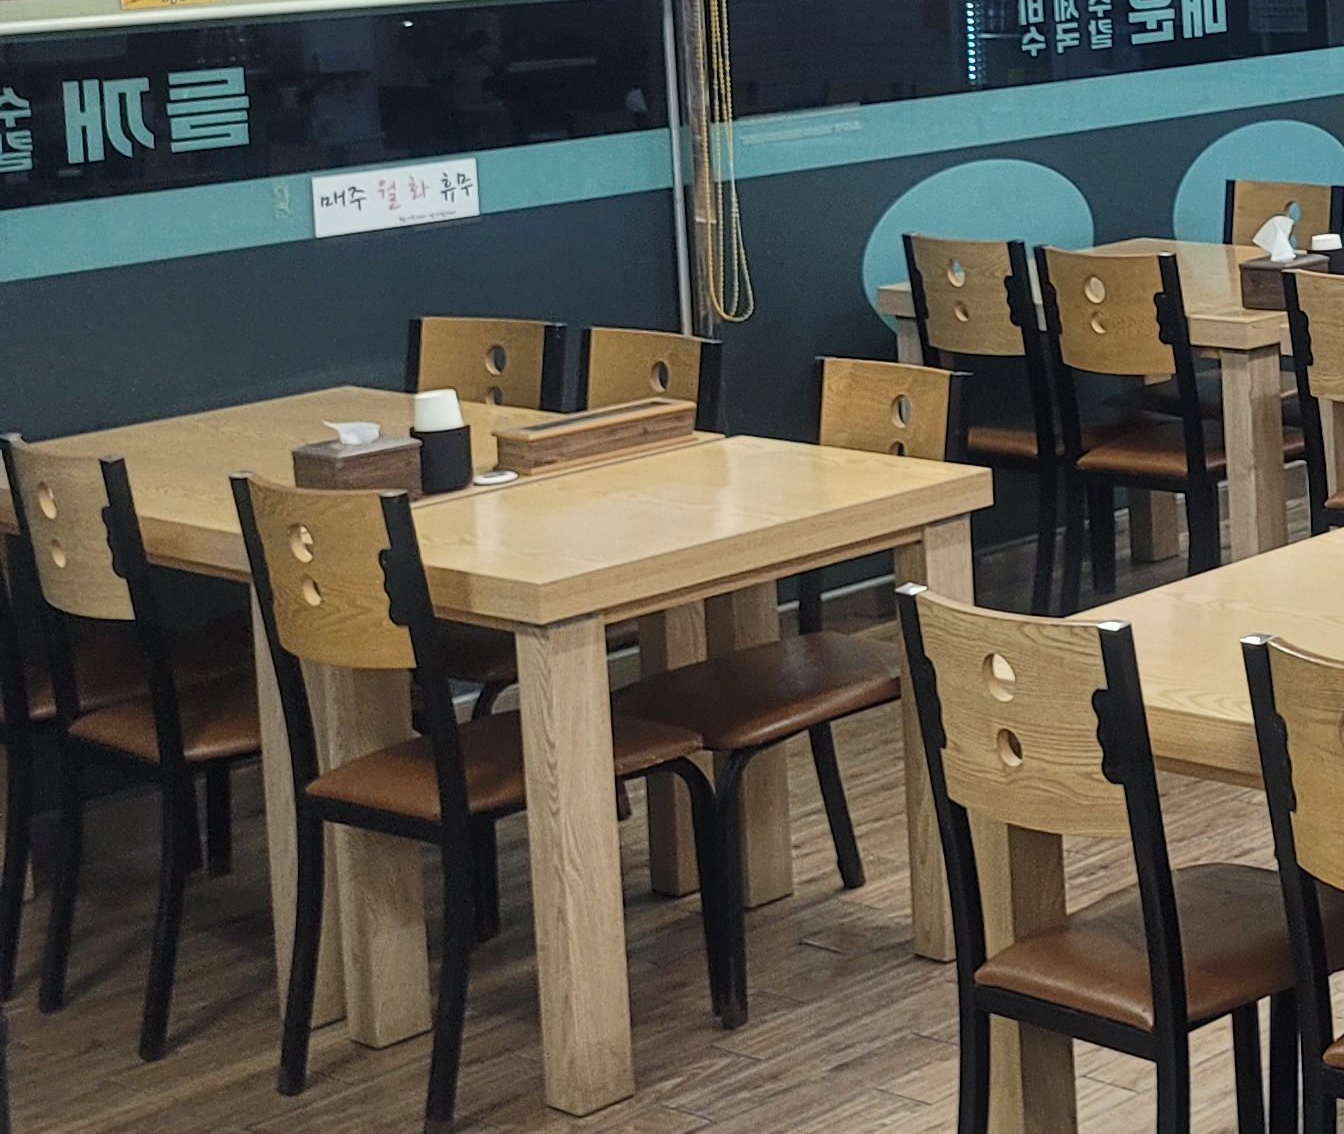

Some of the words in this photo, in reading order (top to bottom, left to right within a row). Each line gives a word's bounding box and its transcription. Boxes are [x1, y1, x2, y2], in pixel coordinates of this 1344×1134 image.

[320, 186, 366, 211] 매주
[378, 180, 400, 210] 월
[408, 176, 430, 200] 화
[440, 172, 474, 203] 휴무
